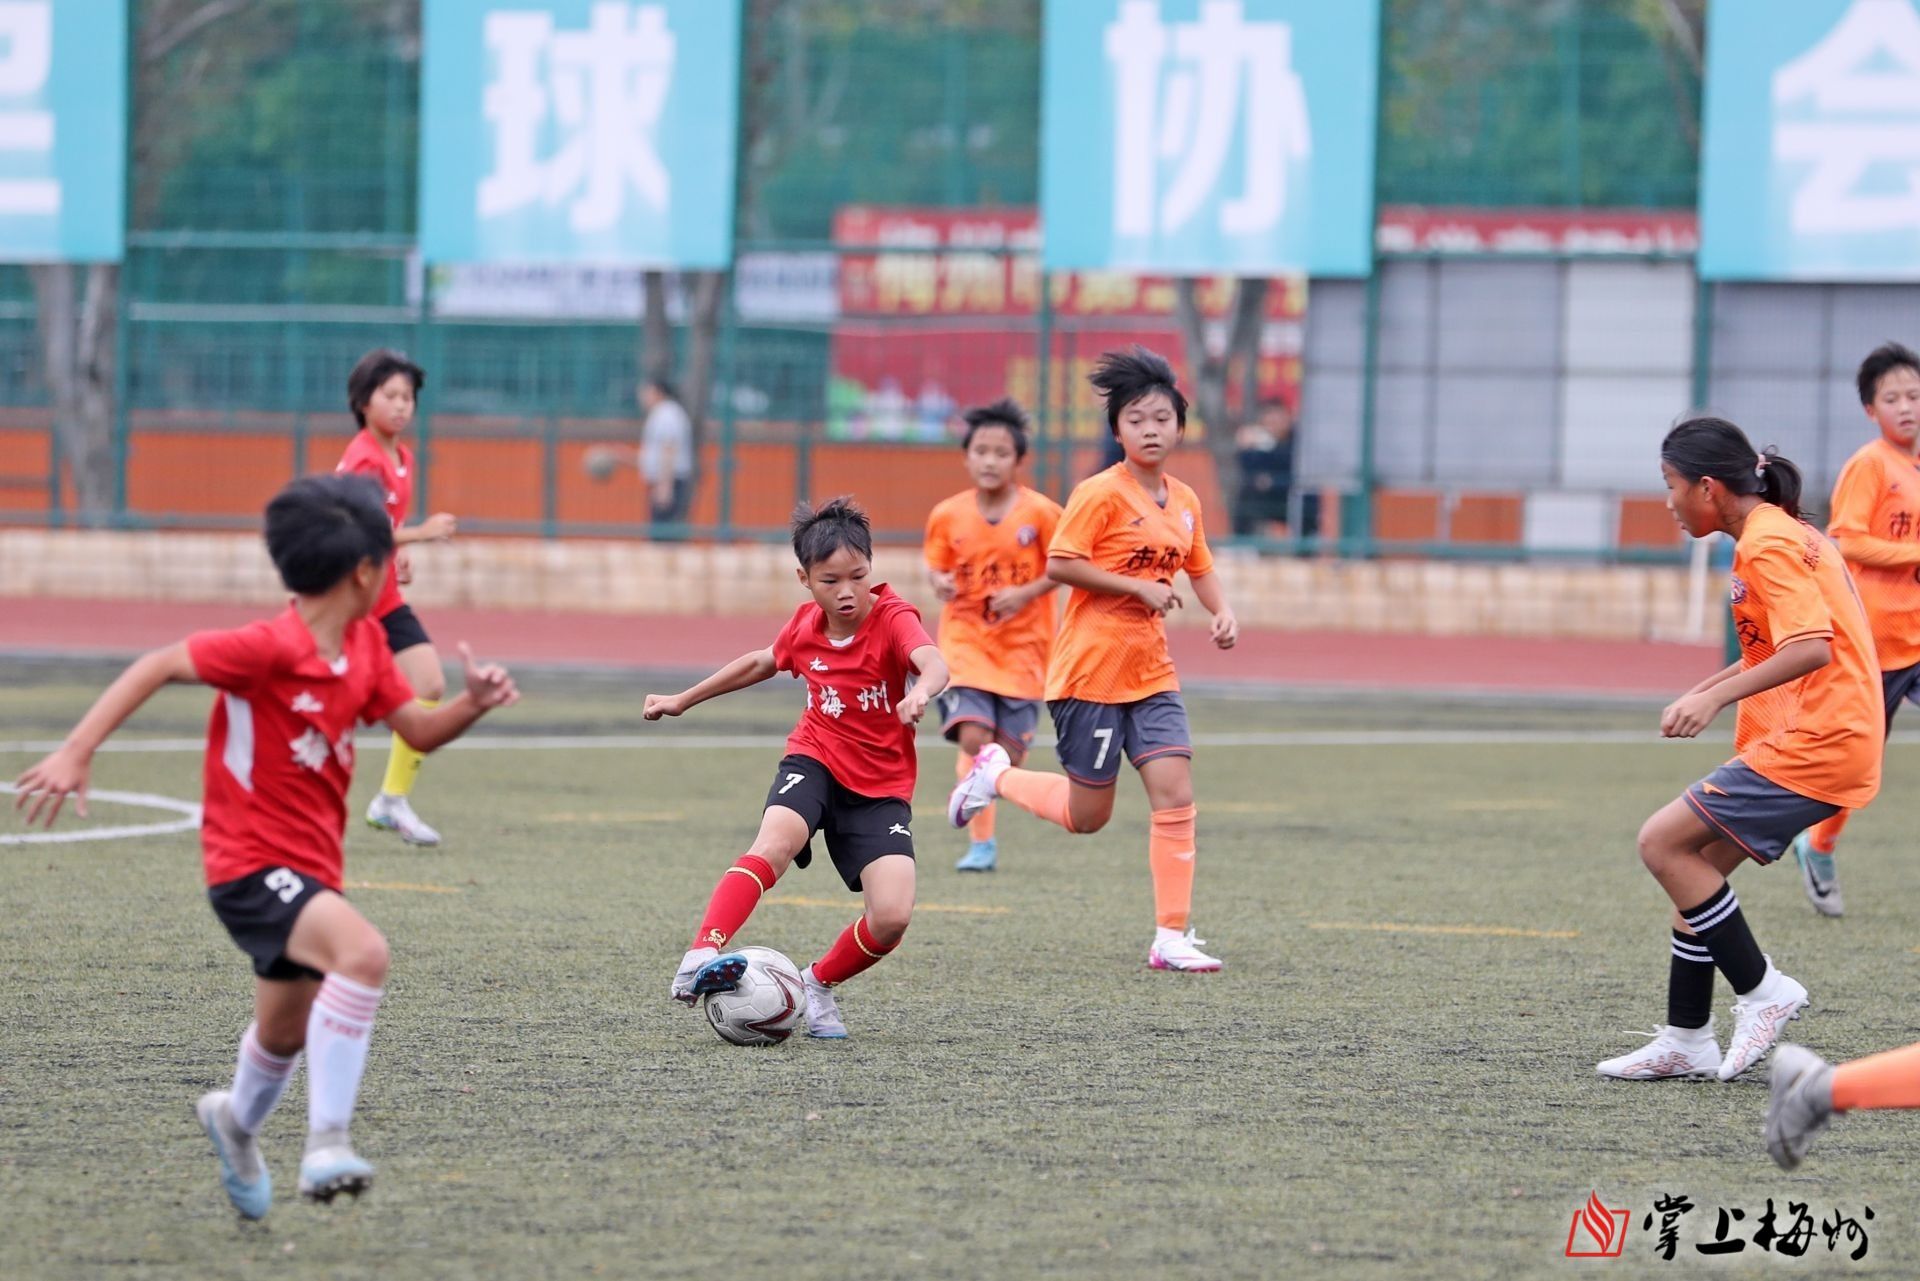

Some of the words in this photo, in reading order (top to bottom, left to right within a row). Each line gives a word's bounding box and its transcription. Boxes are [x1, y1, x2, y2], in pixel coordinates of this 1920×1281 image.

[476, 0, 676, 233] 球
[1106, 0, 1312, 237] 协
[1092, 728, 1114, 770] 7
[778, 773, 805, 795] 7
